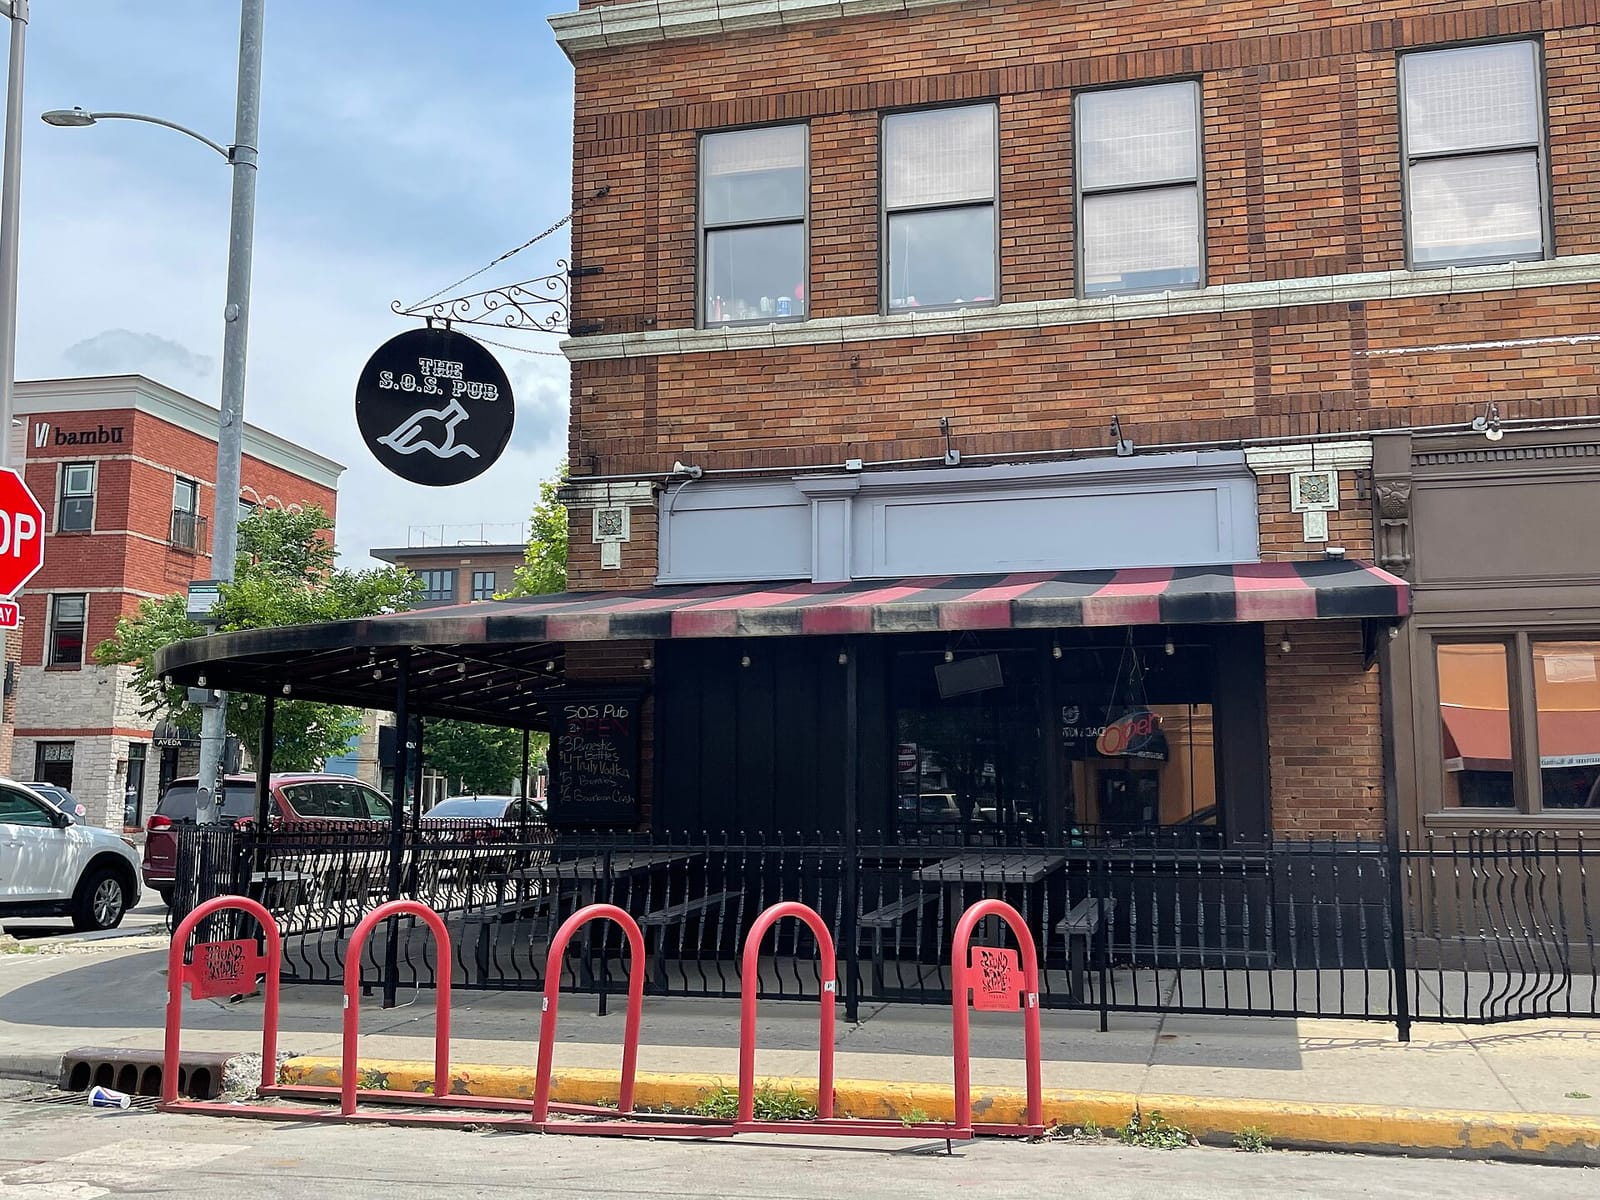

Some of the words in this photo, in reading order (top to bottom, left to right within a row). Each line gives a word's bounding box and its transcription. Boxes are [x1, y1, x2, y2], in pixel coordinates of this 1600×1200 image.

[418, 357, 463, 379] THE
[378, 370, 443, 395] S.O.S.
[452, 379, 499, 401] PUB
[603, 704, 629, 719] Pub
[157, 739, 182, 747] AVEDA
